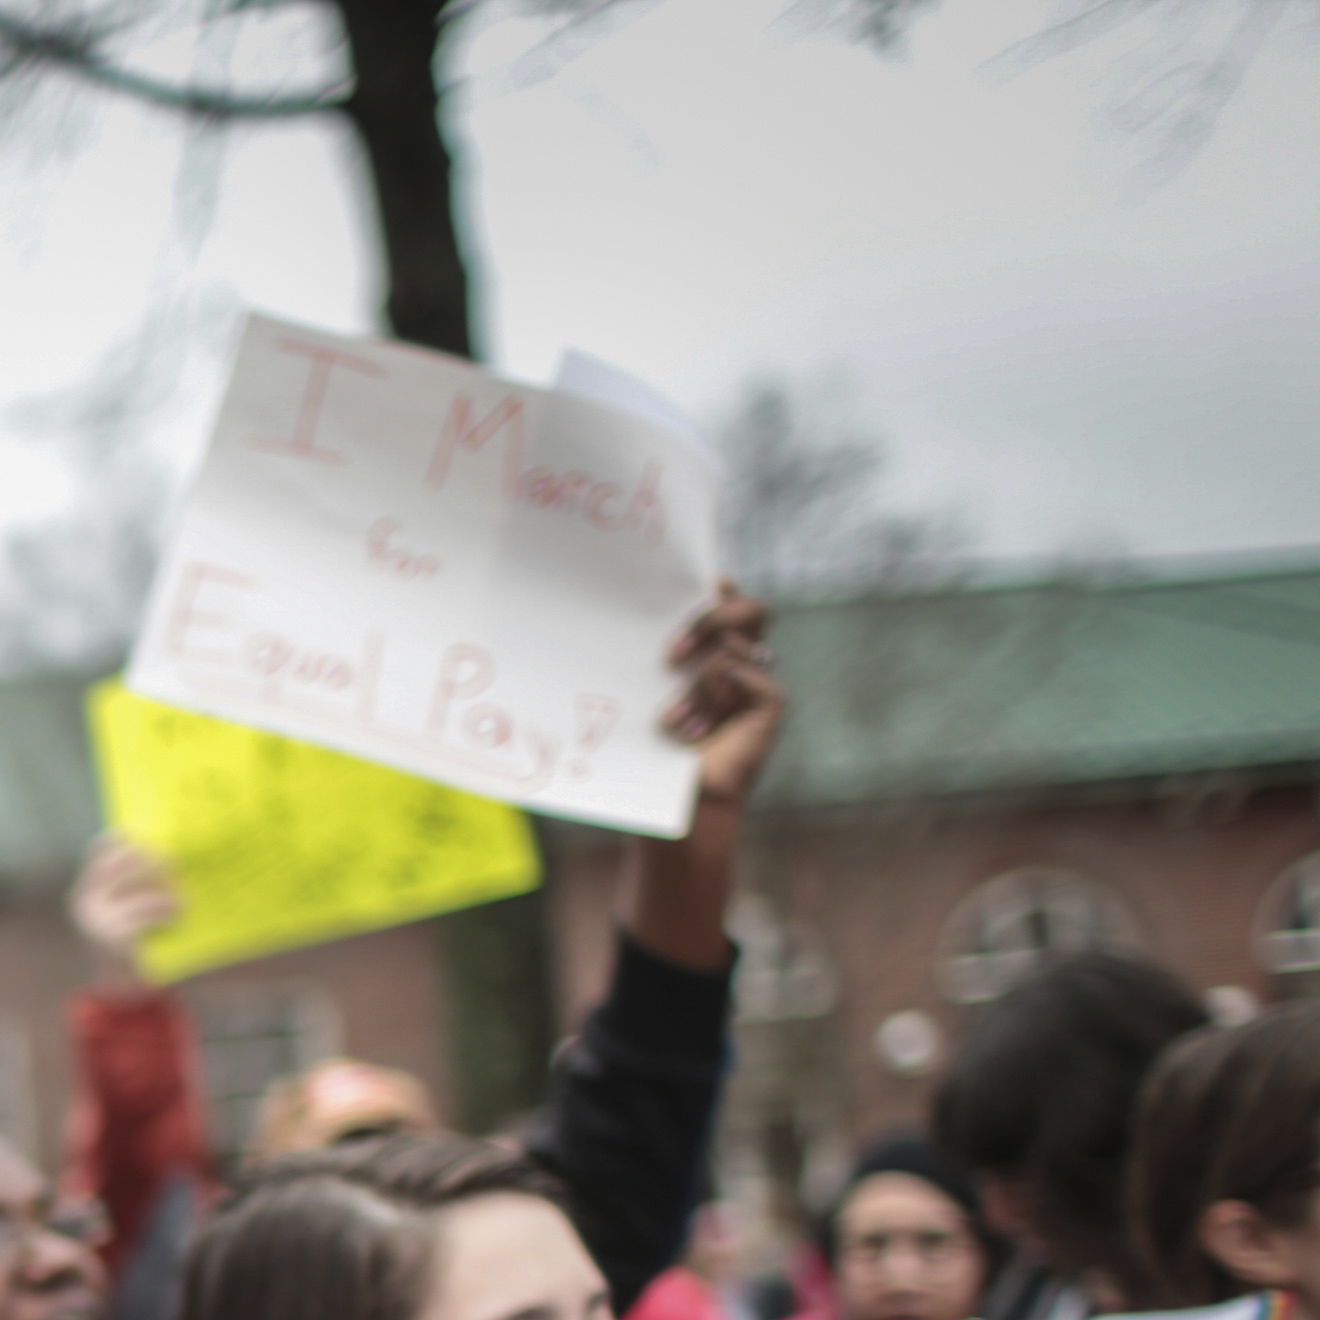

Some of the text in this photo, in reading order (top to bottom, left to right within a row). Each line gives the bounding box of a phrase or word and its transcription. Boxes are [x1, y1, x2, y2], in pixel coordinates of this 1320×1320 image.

[249, 338, 670, 541] I March
[166, 564, 384, 720] Equal
